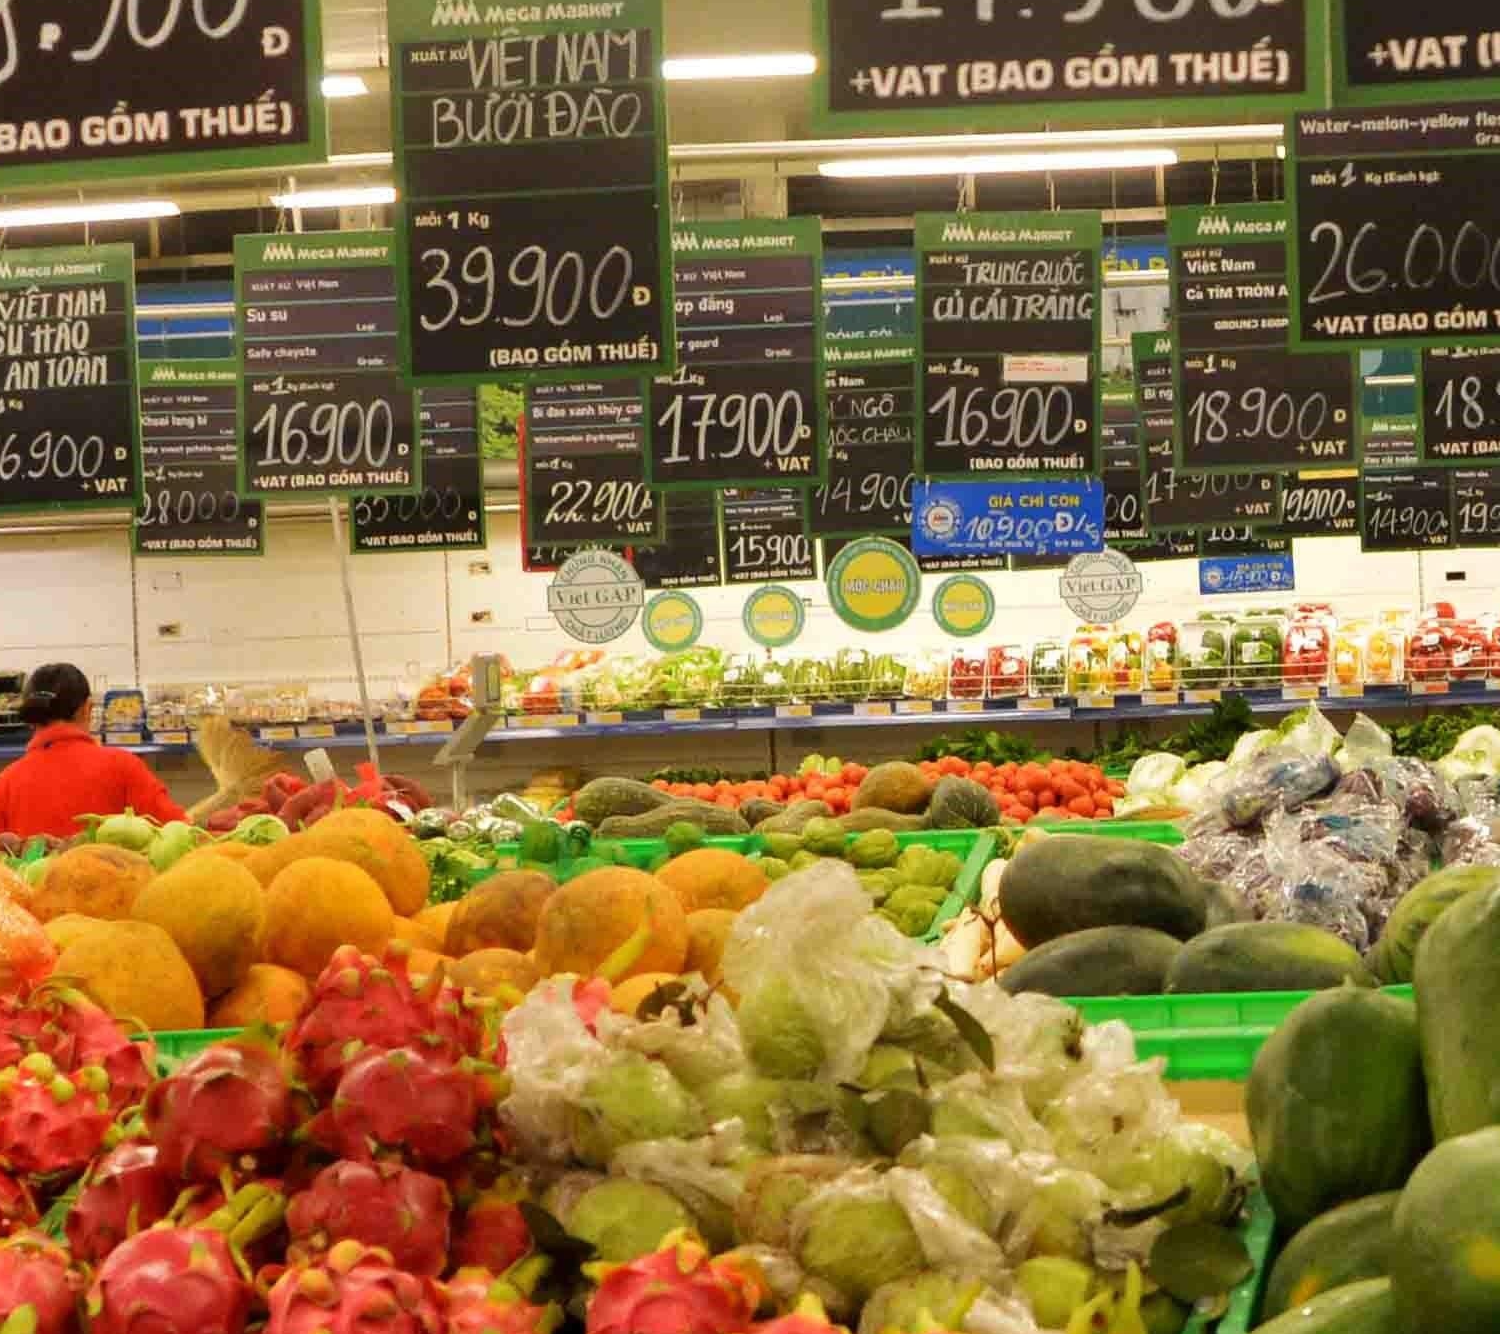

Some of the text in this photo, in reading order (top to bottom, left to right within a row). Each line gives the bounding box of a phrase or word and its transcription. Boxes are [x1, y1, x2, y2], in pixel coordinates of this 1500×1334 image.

[555, 29, 637, 84] NAM
[246, 310, 287, 323] Su su
[420, 245, 633, 331] 39.900
[4, 362, 40, 391] AN
[489, 346, 538, 366] (BAO
[253, 398, 393, 467] 16.900
[658, 389, 803, 464] 17.900
[928, 386, 1072, 448] 16.900
[1188, 386, 1327, 444] 18.900
